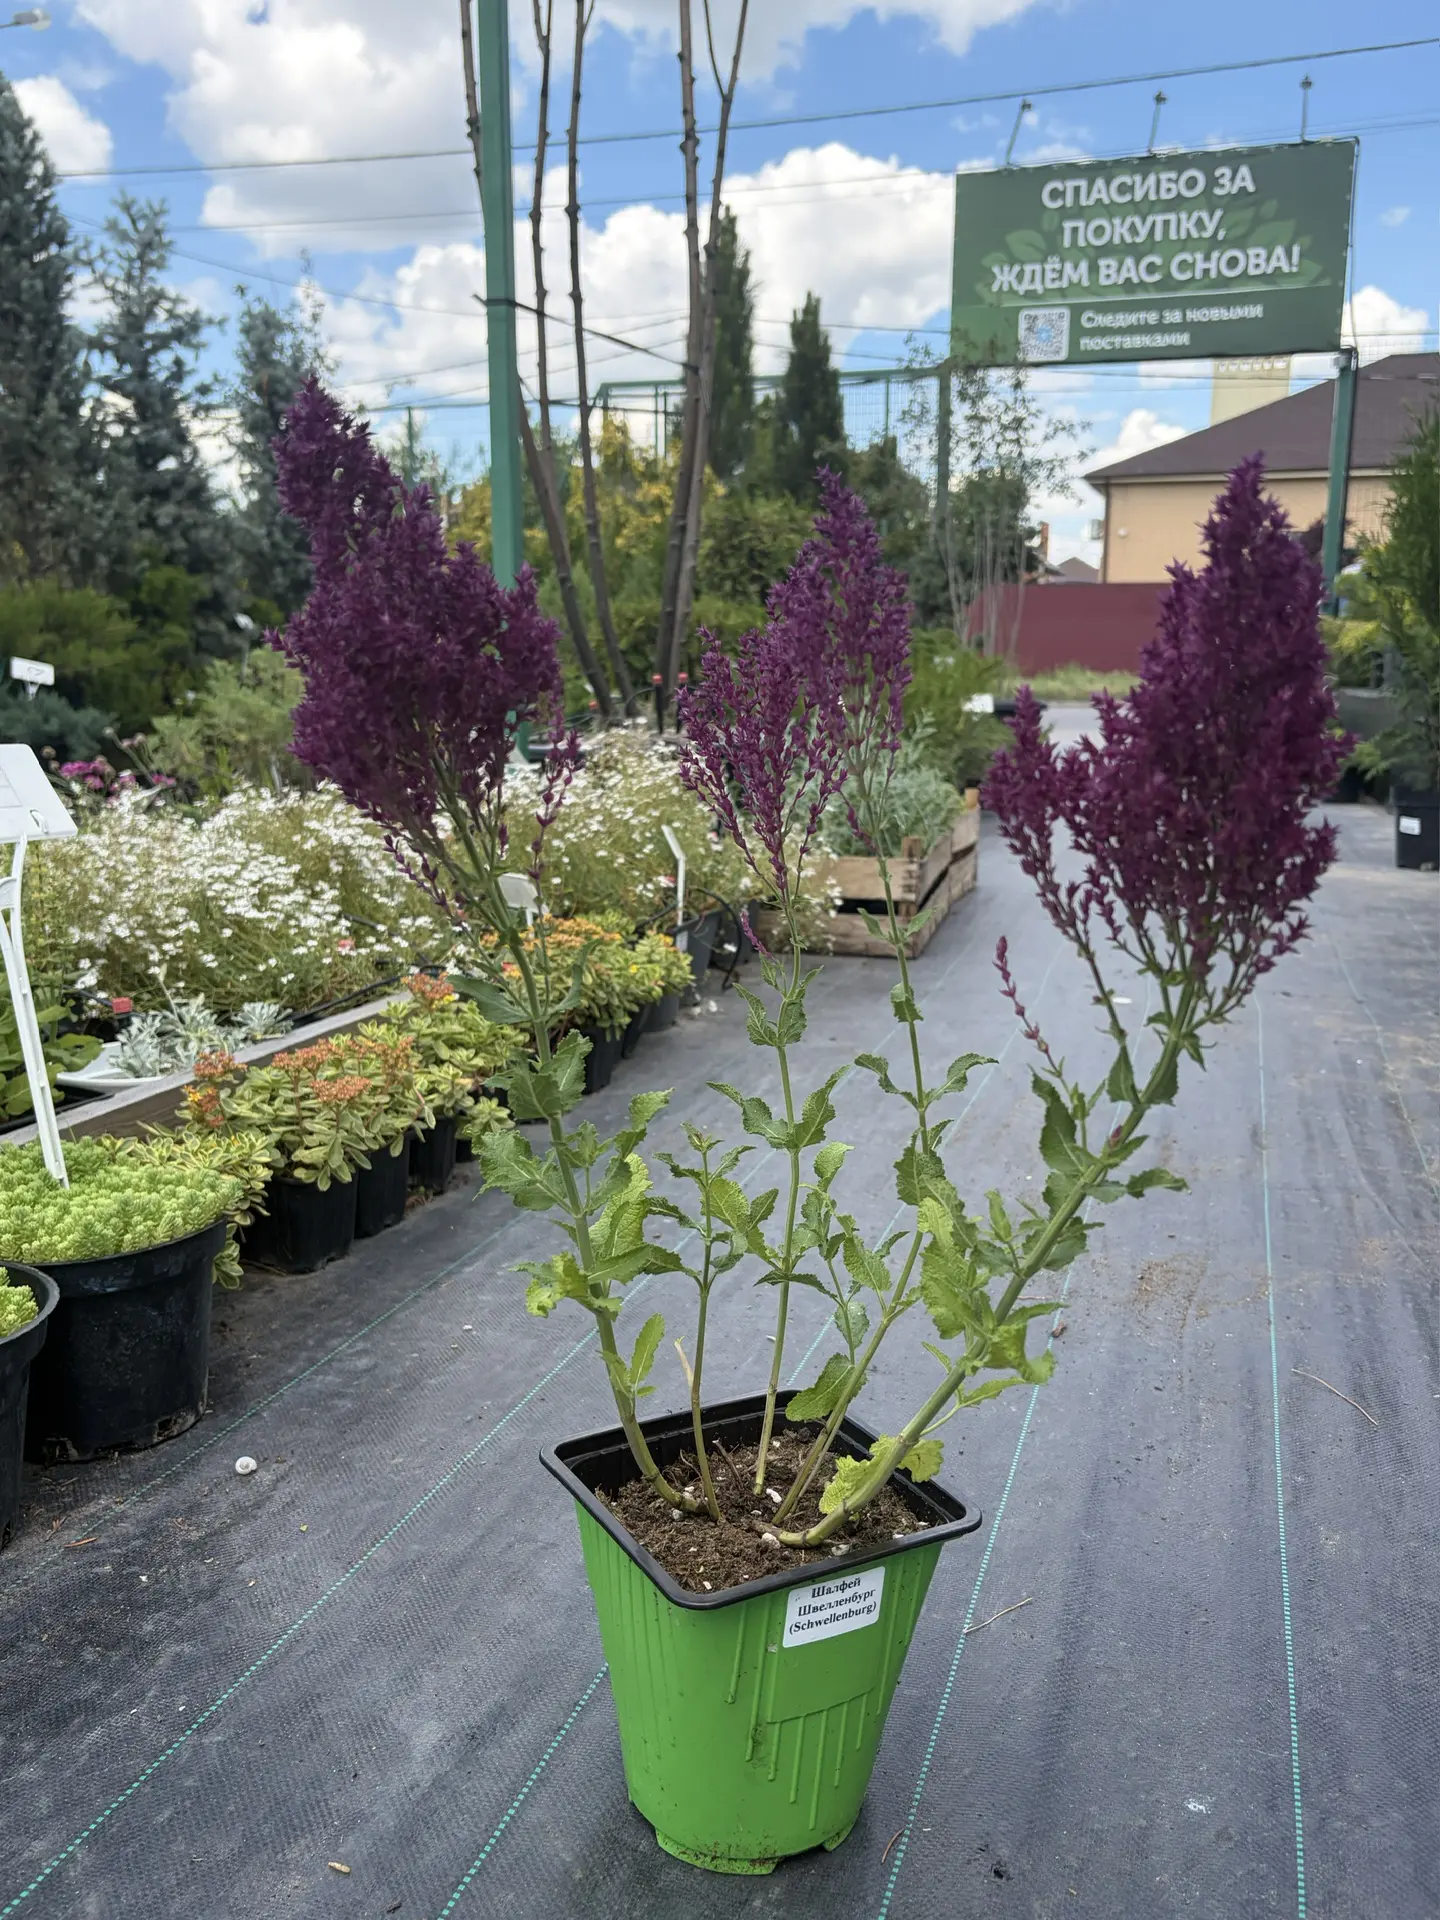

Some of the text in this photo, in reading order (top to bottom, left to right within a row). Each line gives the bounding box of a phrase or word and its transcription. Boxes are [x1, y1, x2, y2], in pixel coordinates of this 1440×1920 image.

[1041, 164, 1255, 208] СПАСИБО ЗА
[1062, 209, 1225, 248] ПОКУПКУ,
[991, 245, 1300, 294] ЖДЁМ ВАС СНОВА!
[1081, 304, 1263, 329] Следите за новыми
[1079, 332, 1190, 351] поставками
[798, 1589, 876, 1616] Швелленбург
[811, 1577, 861, 1598] Шалфей
[789, 1601, 877, 1635] (Schwellenburg)
